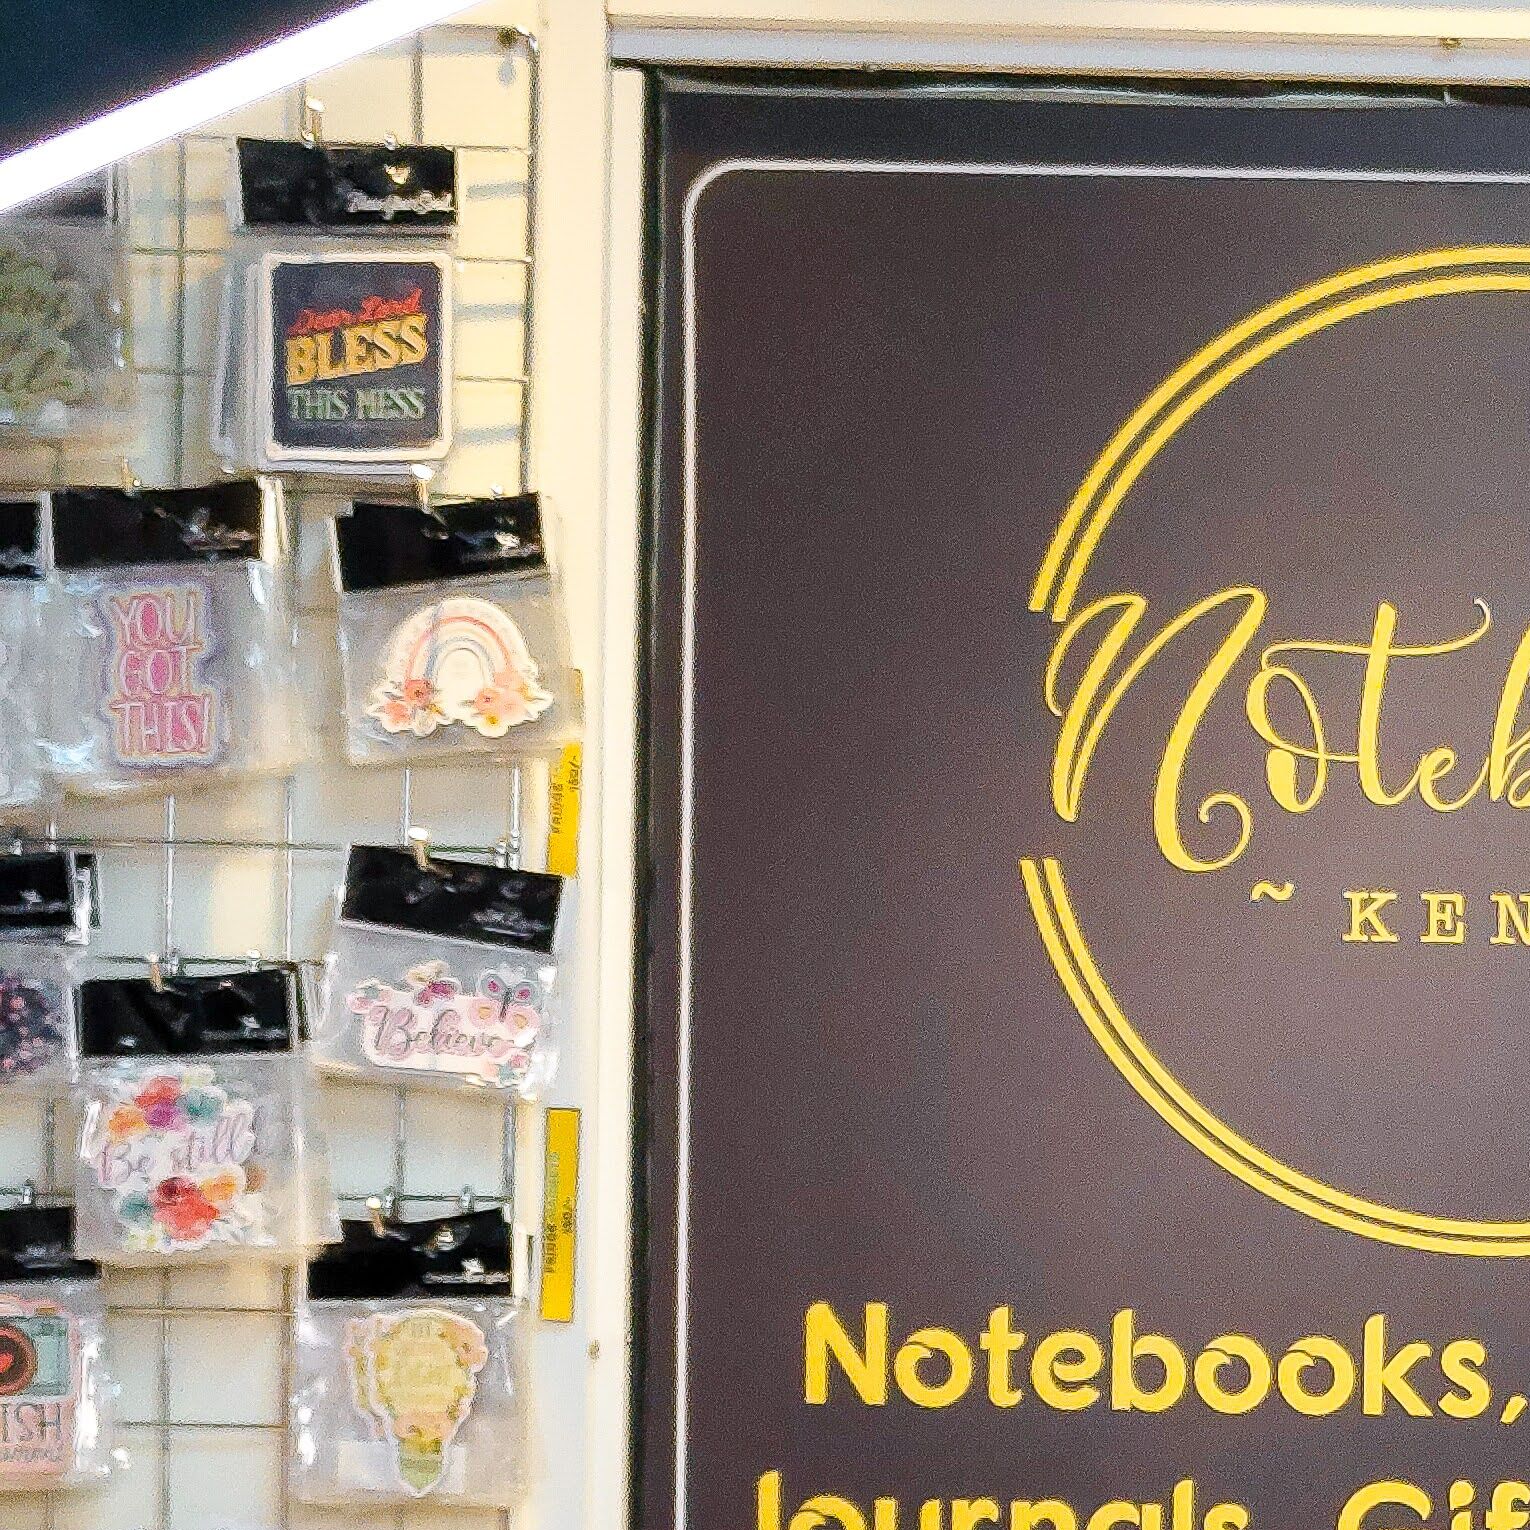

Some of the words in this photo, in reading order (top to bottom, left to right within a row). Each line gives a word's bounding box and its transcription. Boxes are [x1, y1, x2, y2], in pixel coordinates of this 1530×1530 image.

[285, 313, 428, 387] BLESS
[286, 388, 350, 421] THIS
[354, 387, 427, 421] MESS
[108, 590, 202, 648] YOU
[803, 1300, 1528, 1424] Notebooks,
